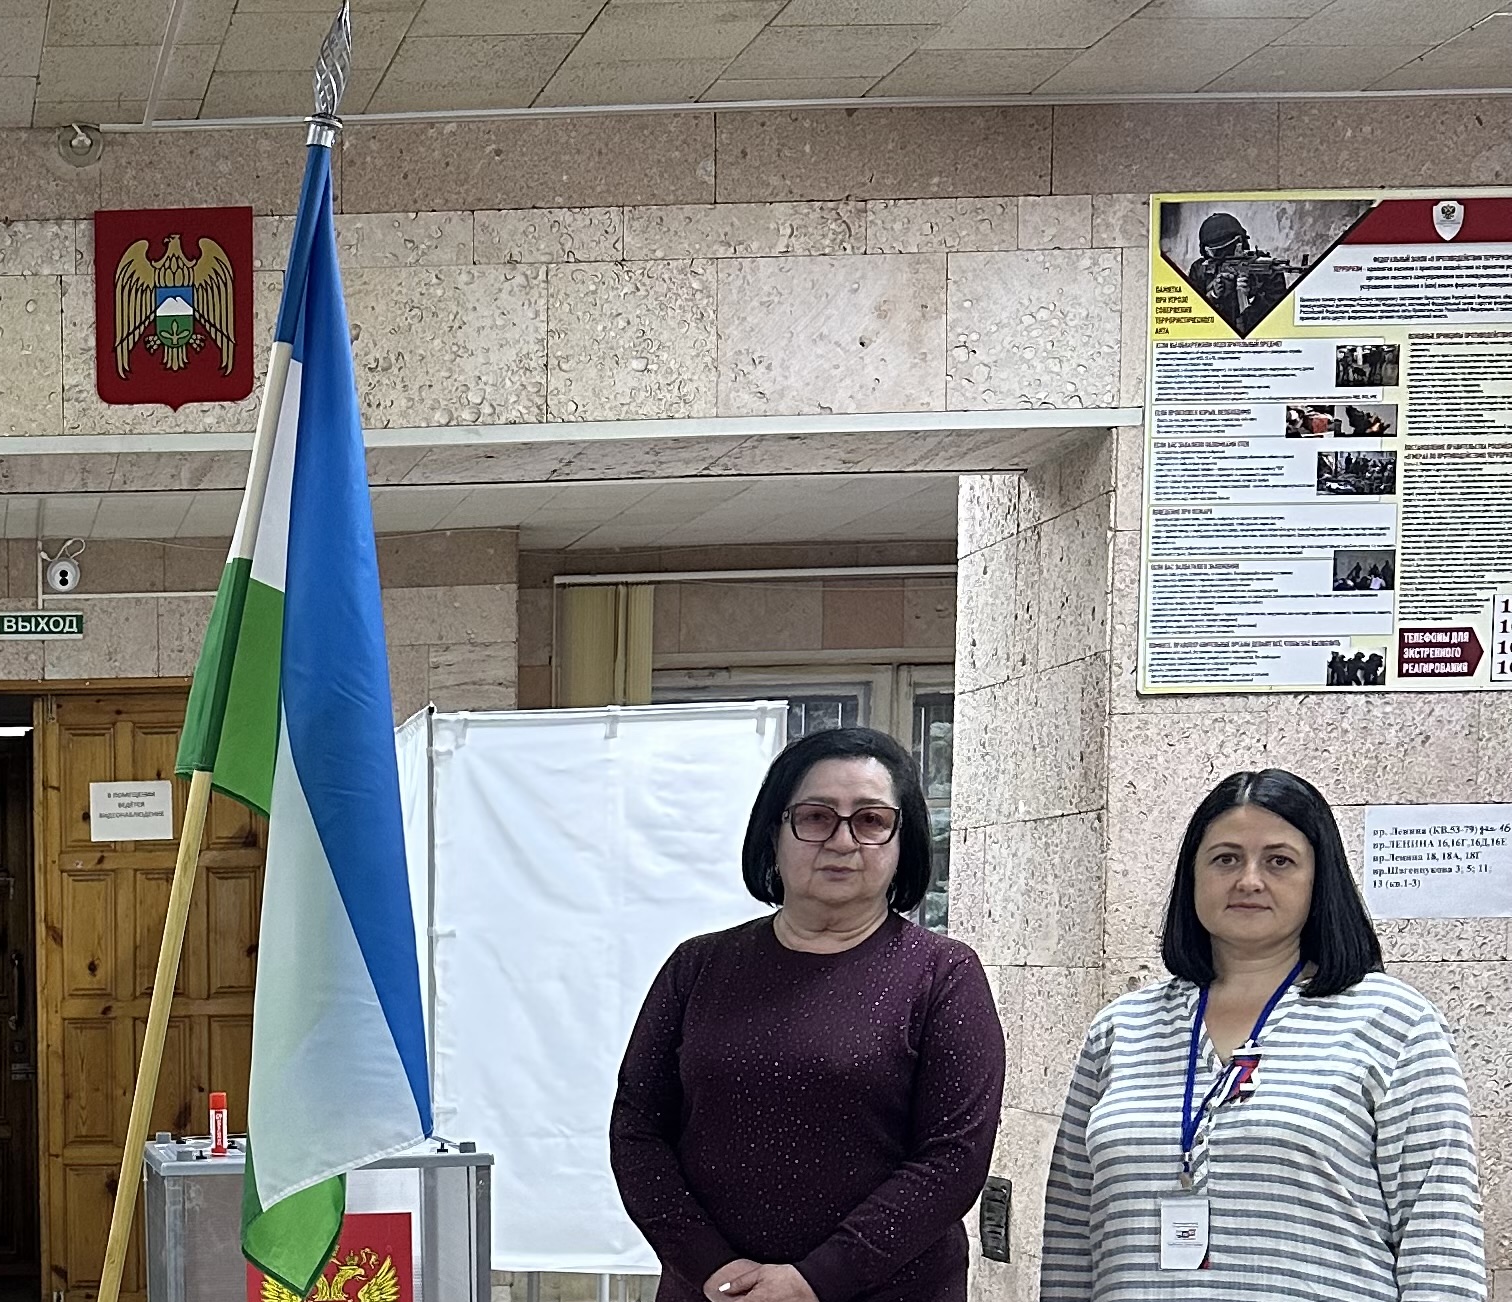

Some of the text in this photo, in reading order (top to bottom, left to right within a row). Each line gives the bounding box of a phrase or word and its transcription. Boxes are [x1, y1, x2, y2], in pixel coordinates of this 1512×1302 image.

[3, 616, 78, 633] ВЫХОД
[1403, 631, 1469, 644] ТЕЛЕФОНЫ ДЛЯ
[1403, 646, 1462, 658] ЭКСТРЕННОГО
[1373, 879, 1383, 888] 13
